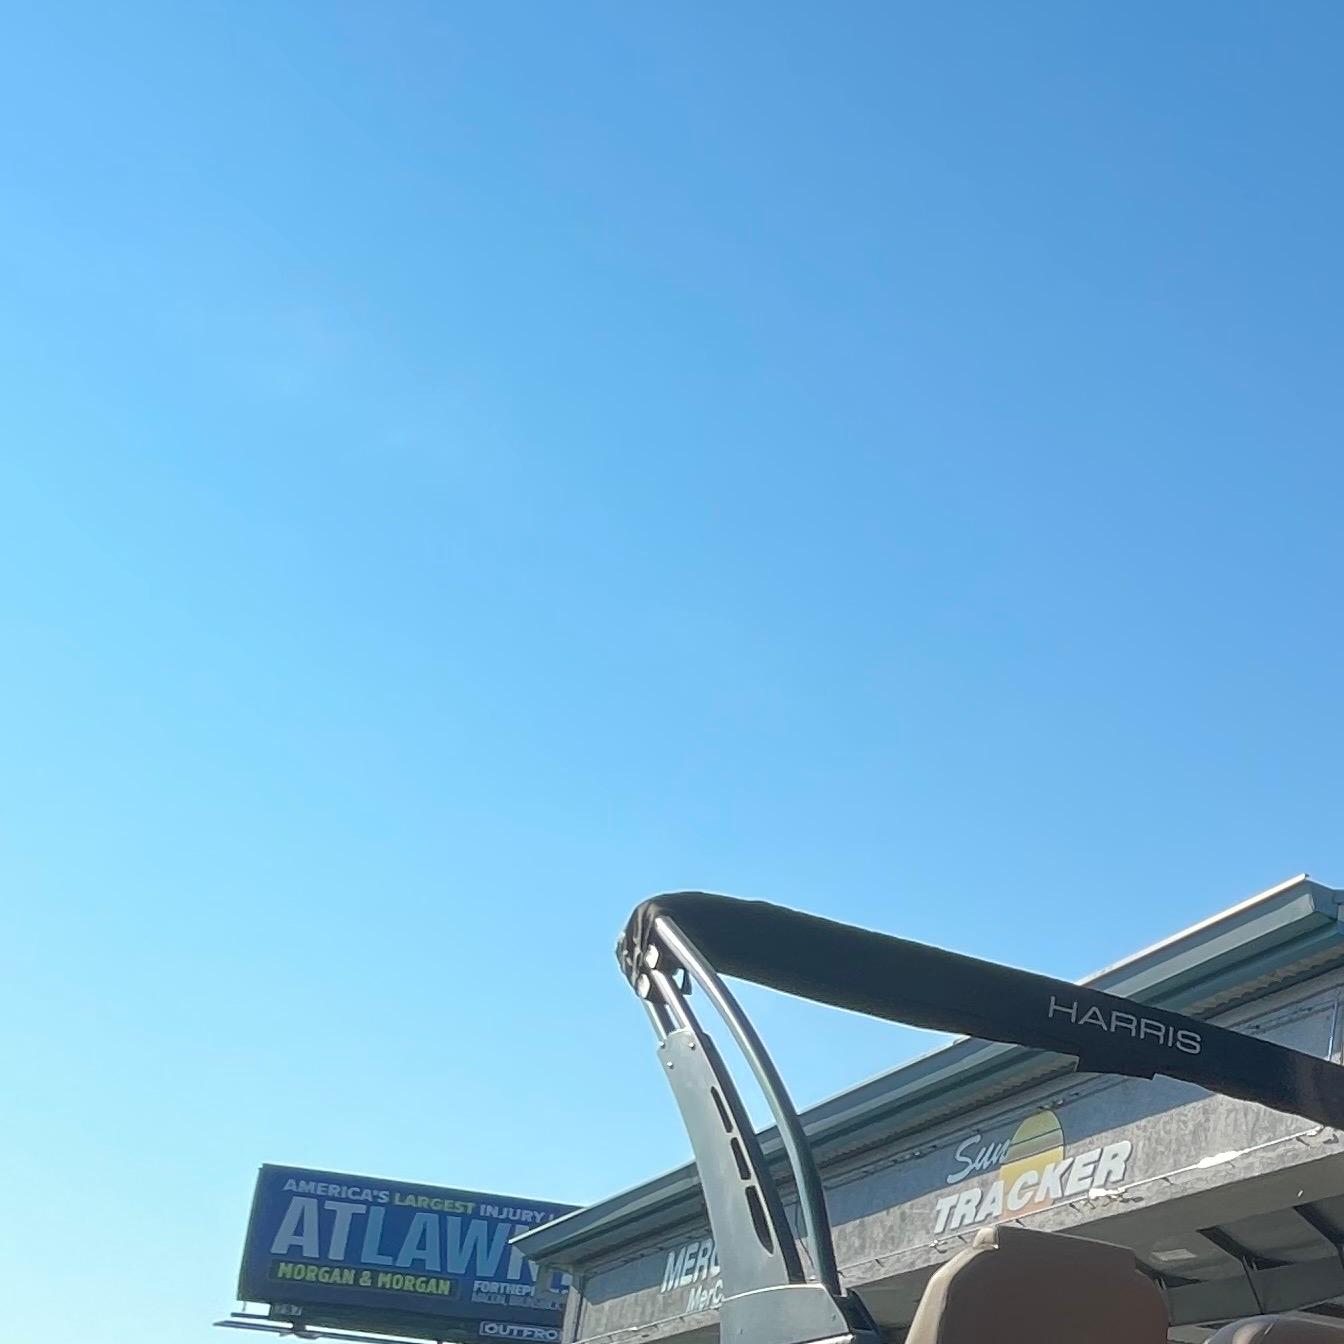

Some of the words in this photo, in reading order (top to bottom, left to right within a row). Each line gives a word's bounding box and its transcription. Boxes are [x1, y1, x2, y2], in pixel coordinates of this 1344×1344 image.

[1047, 995, 1201, 1056] HARRIS
[946, 1134, 1010, 1184] Sun
[283, 1179, 390, 1204] AMERICA'S
[394, 1193, 475, 1214] LARGEST
[480, 1204, 545, 1223] INJURY
[933, 1140, 1132, 1234] TRACKER
[278, 1262, 356, 1285] MORGAN
[359, 1270, 371, 1286] &
[377, 1273, 451, 1295] MORGAN
